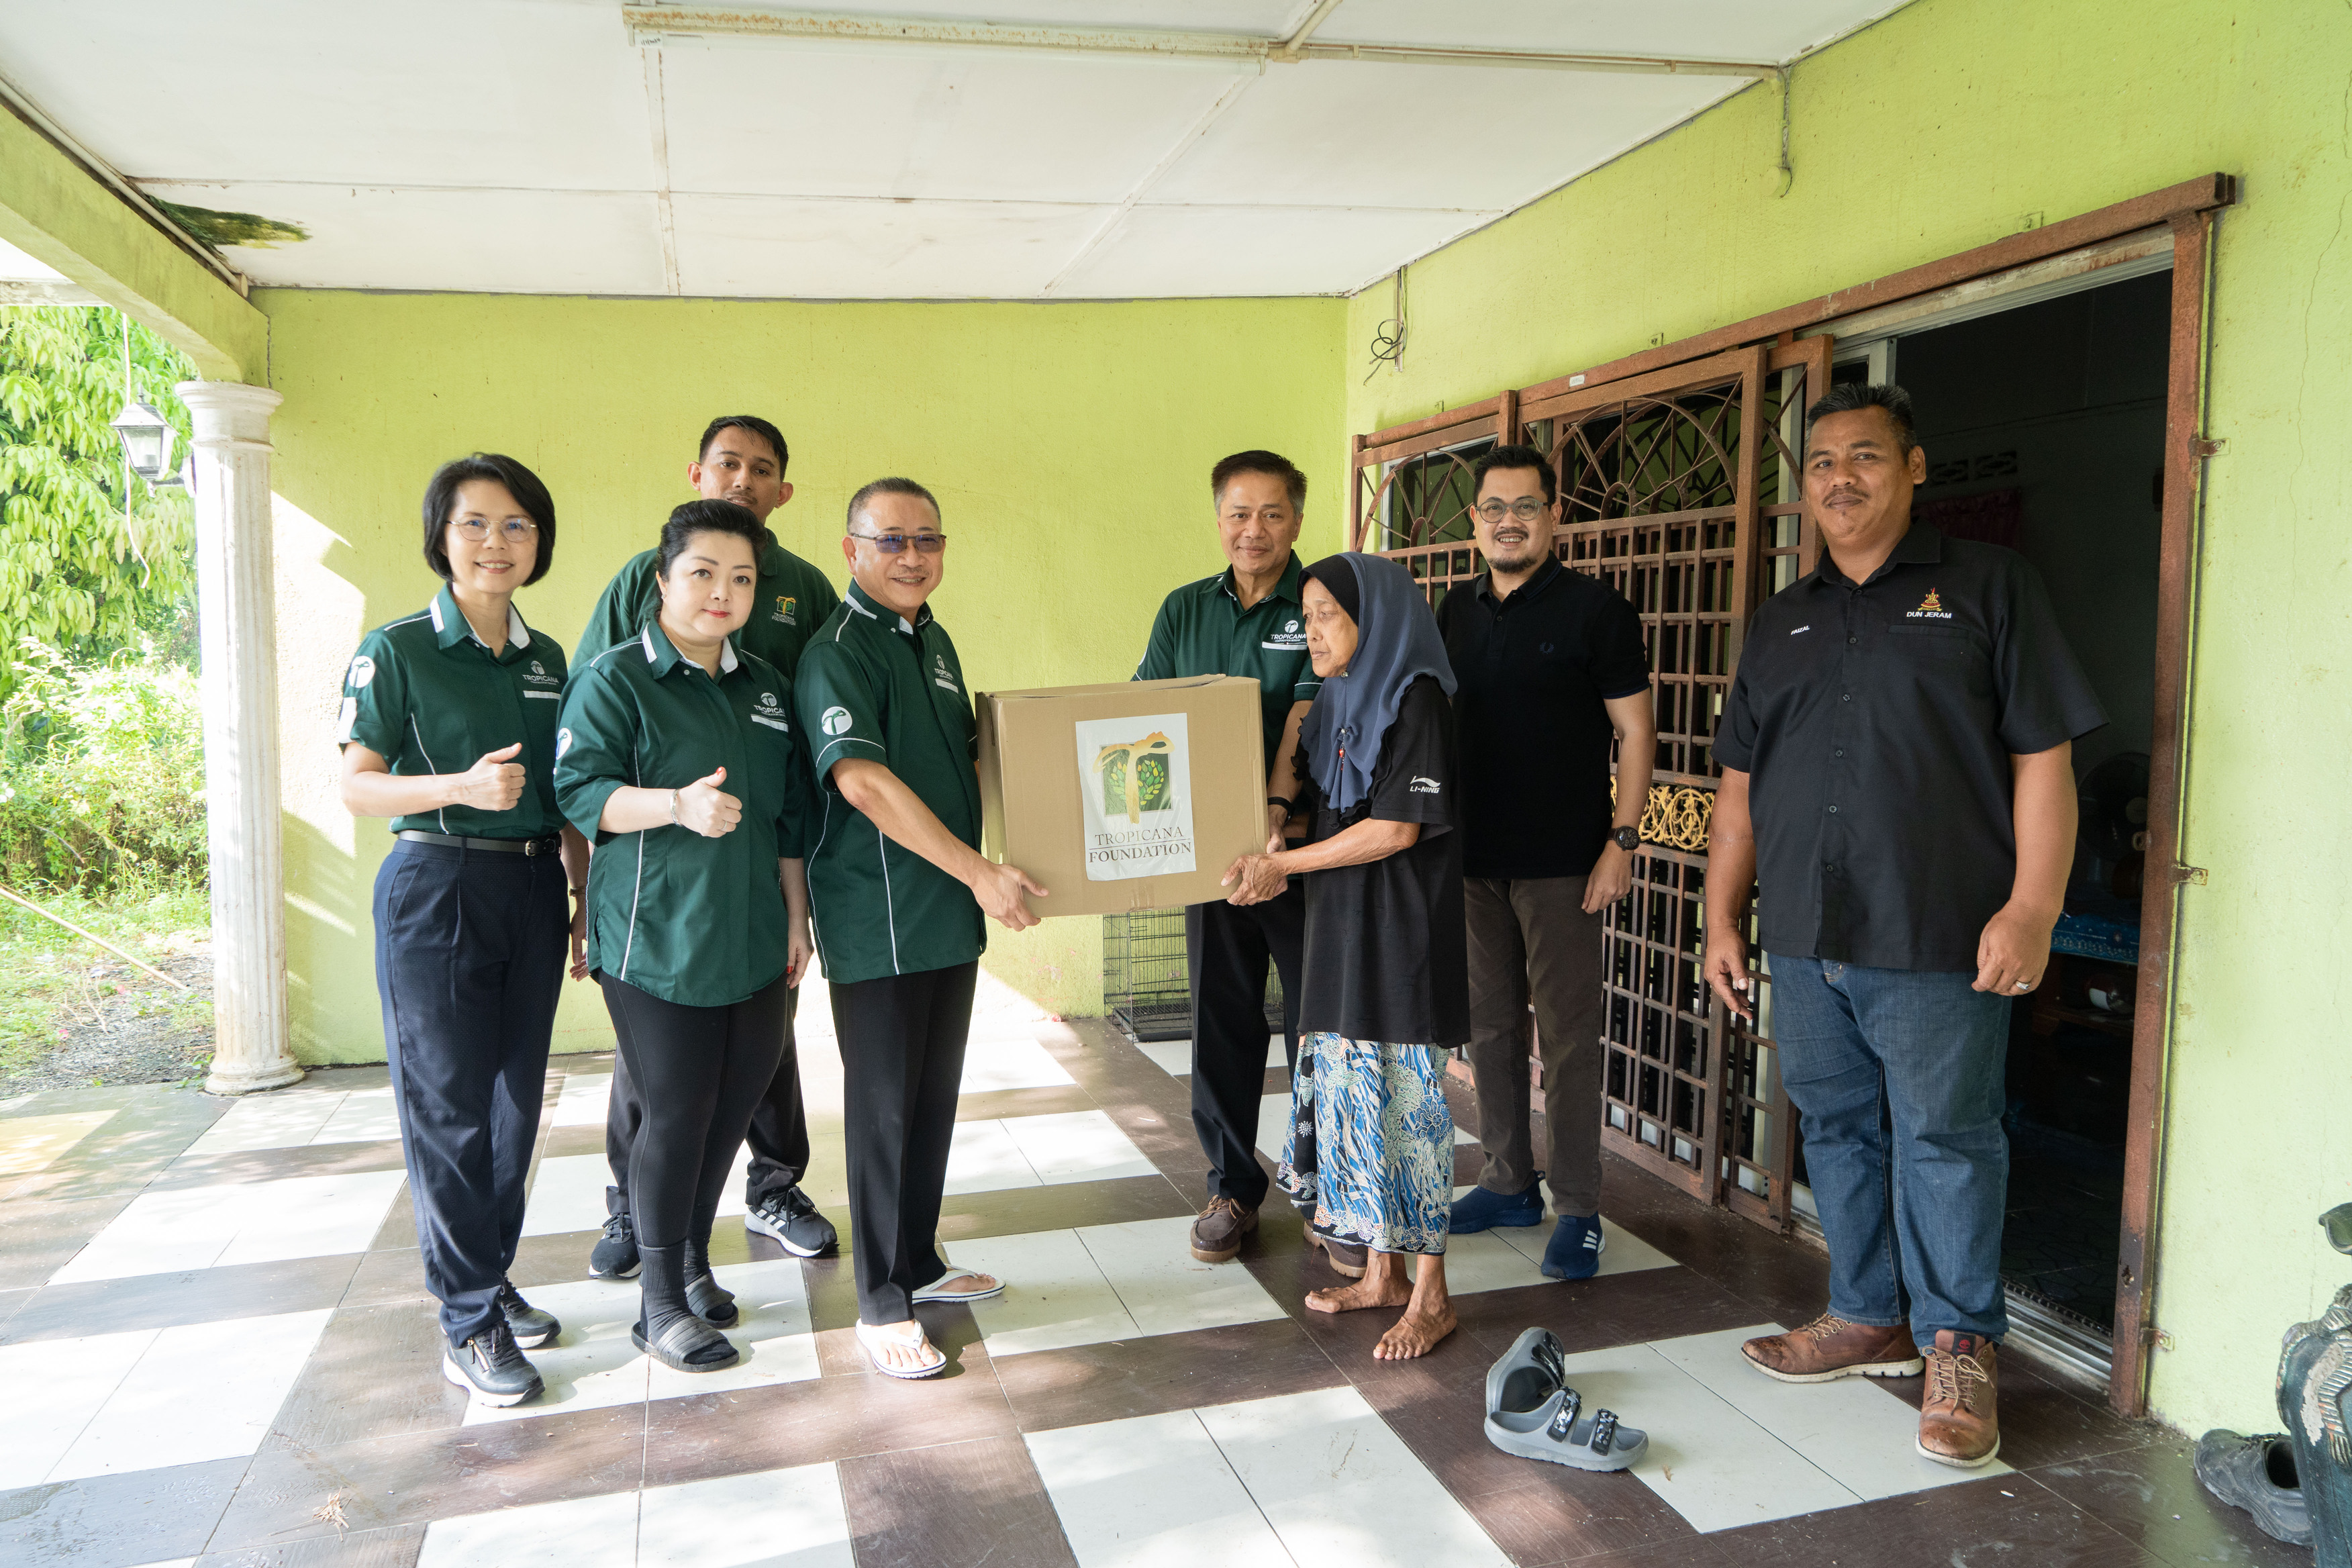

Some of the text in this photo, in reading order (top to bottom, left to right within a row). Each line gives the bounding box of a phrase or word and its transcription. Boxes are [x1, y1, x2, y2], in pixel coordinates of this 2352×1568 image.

[1791, 625, 1810, 635] FAIZAL
[522, 675, 559, 683] TROPICANA
[1095, 827, 1184, 846] TROPICANA
[1089, 842, 1191, 863] FOUNDATION
